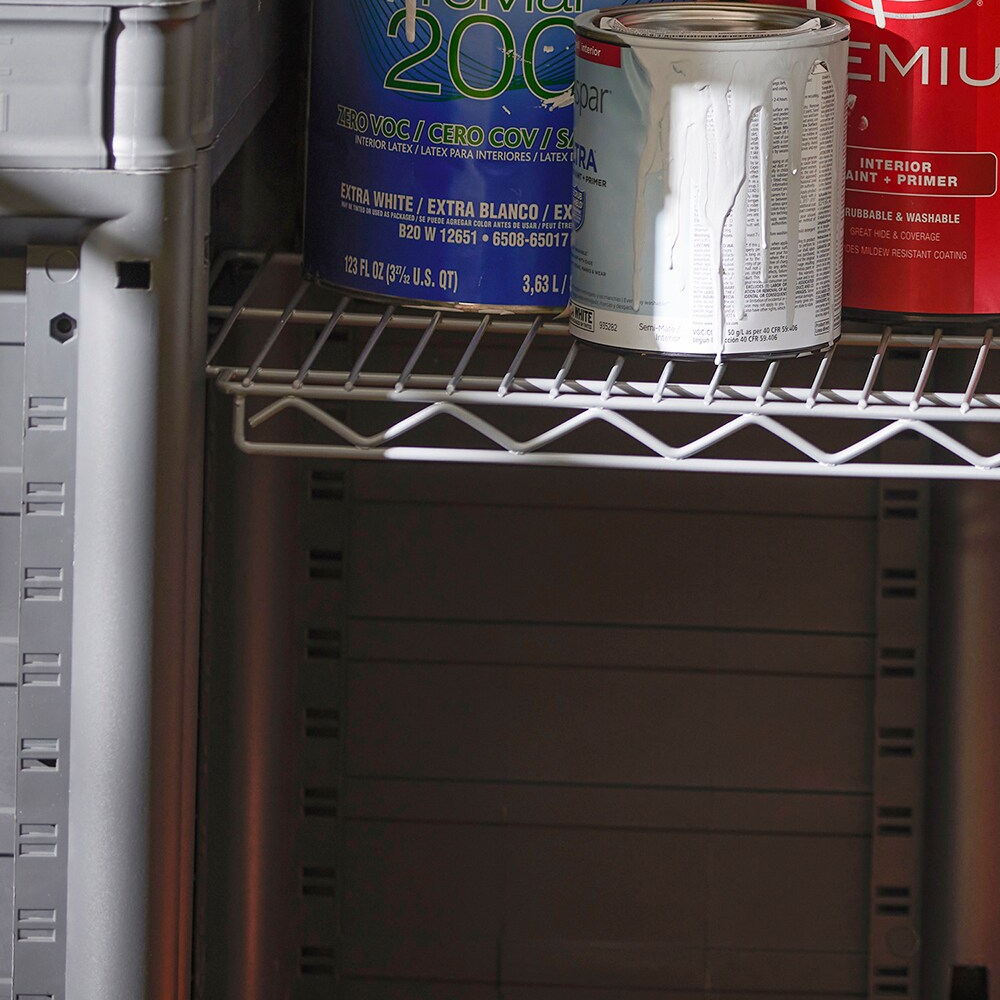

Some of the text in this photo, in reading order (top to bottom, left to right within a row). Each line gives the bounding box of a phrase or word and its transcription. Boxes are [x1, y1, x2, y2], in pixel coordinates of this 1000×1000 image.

[574, 80, 608, 116] spar
[337, 104, 369, 133] ZERO
[370, 114, 410, 141] VOC
[428, 122, 485, 147] CERO
[489, 126, 540, 149] COV
[355, 135, 386, 150] INTERIOR
[388, 142, 413, 154] LATEX
[421, 146, 448, 157] LATEX
[450, 148, 474, 159] PARA
[476, 150, 531, 162] INTERIORES
[540, 153, 568, 162] LATEX
[575, 142, 597, 173] TRA
[860, 157, 932, 173] INTERIOR
[586, 175, 607, 188] PRIMER
[846, 170, 878, 183] AINT
[897, 174, 958, 187] PRIMER
[341, 182, 370, 206] EXTRA
[373, 190, 414, 212] WHITE
[428, 198, 475, 218] EXTRA
[480, 202, 539, 220] BLANCO
[391, 212, 415, 221] PACKAGED
[427, 216, 444, 224] PUEDE
[446, 218, 472, 226] AGREGAR
[473, 220, 492, 228] COLOR
[493, 221, 511, 229] ANTES
[845, 207, 960, 224] RUBBABLE & WASHABLE
[399, 223, 568, 247] B20 W 12651 6508-65017
[850, 227, 940, 242] GREAT HIDE & COVERAGE
[861, 246, 890, 256] MILDEW
[892, 248, 931, 259] RESISTANT
[934, 250, 967, 260] COATING
[345, 255, 358, 274] 123
[360, 259, 370, 277] FL
[372, 261, 384, 280] OZ
[413, 268, 435, 287] U.S.
[439, 269, 459, 293] QT)
[523, 274, 549, 295] 3,63
[552, 275, 559, 292] L
[724, 336, 739, 344] cción
